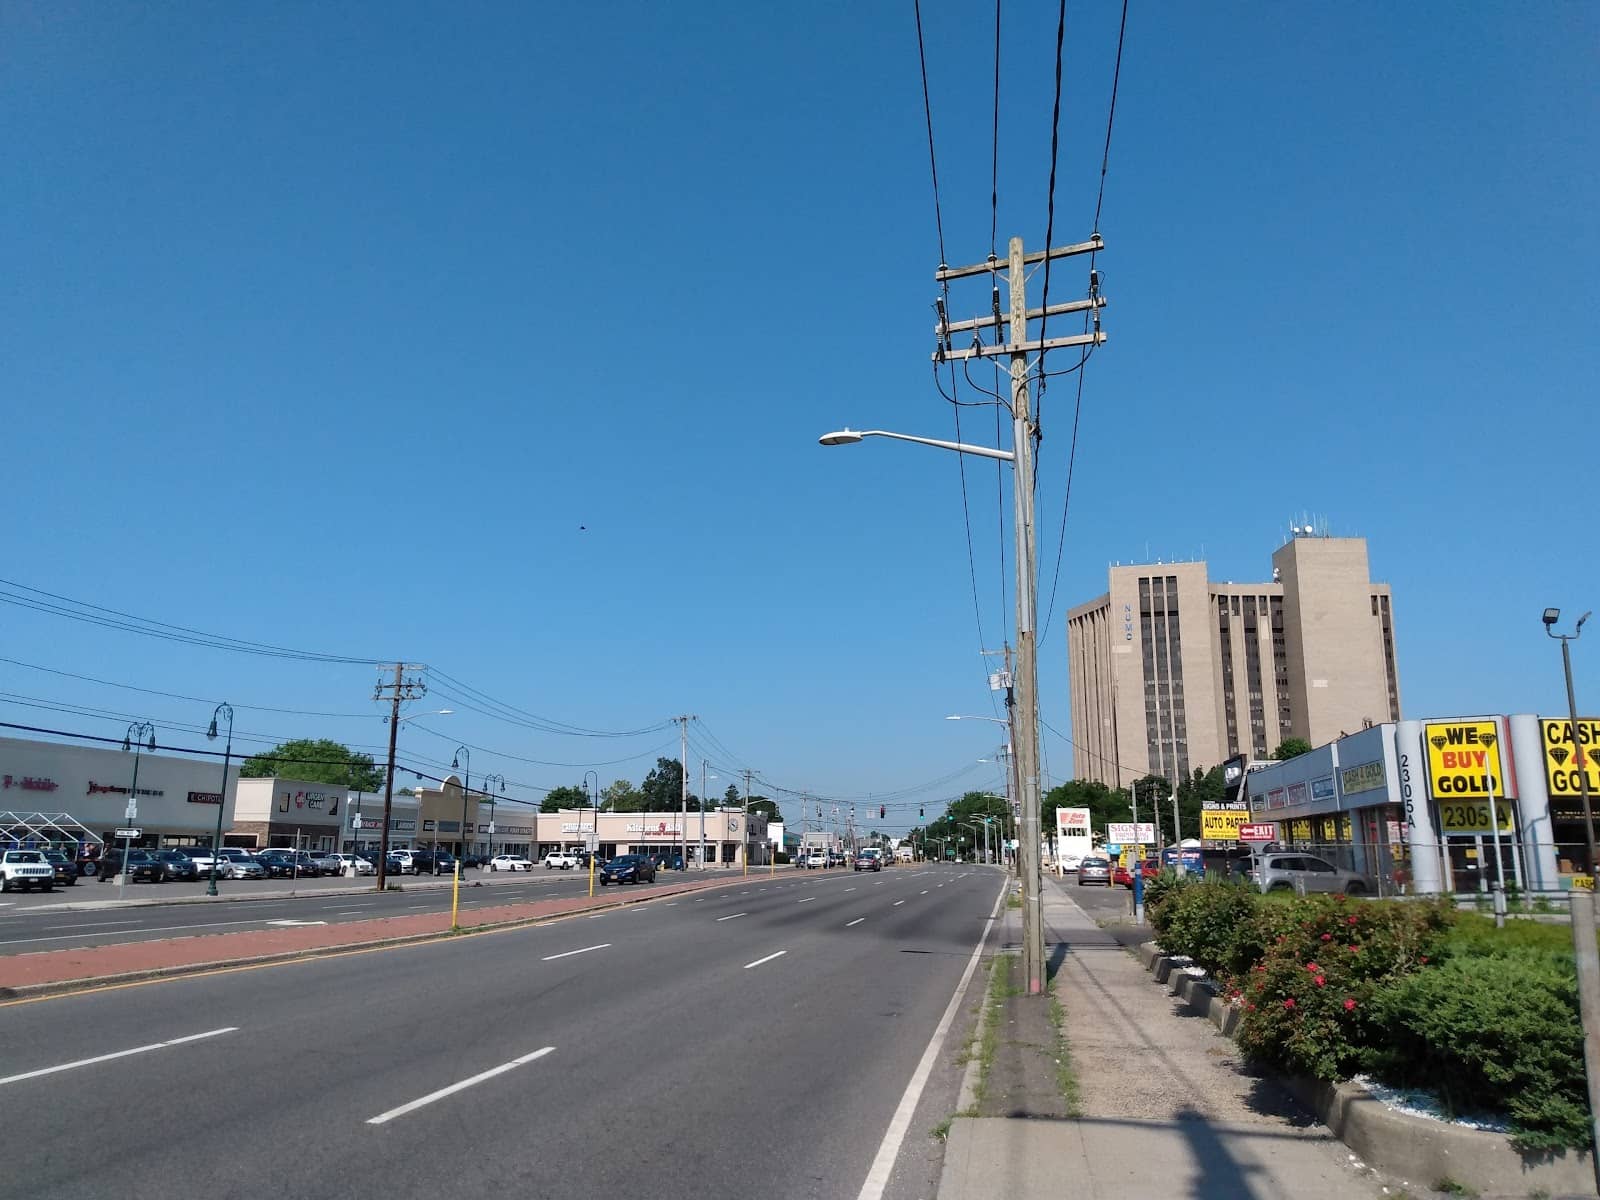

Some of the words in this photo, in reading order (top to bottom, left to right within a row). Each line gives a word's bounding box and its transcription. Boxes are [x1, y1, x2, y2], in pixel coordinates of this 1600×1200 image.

[1124, 603, 1133, 641] NUMC
[1445, 727, 1479, 745] WE
[1547, 723, 1600, 745] CASH
[1442, 750, 1487, 769] BUY
[1571, 746, 1588, 769] 4
[1437, 775, 1497, 793] GOLD
[1553, 769, 1600, 793] GOL
[1400, 754, 1416, 829] 2305A
[1202, 802, 1220, 810] SIGNS
[1221, 802, 1226, 810] &
[1226, 802, 1247, 810] PRINTS
[1204, 817, 1223, 829] AUTO
[1444, 806, 1489, 828] 2305
[1496, 805, 1510, 827] A
[1110, 824, 1143, 832] SIGNS
[1145, 824, 1152, 832] &
[1253, 825, 1274, 836] EXIT
